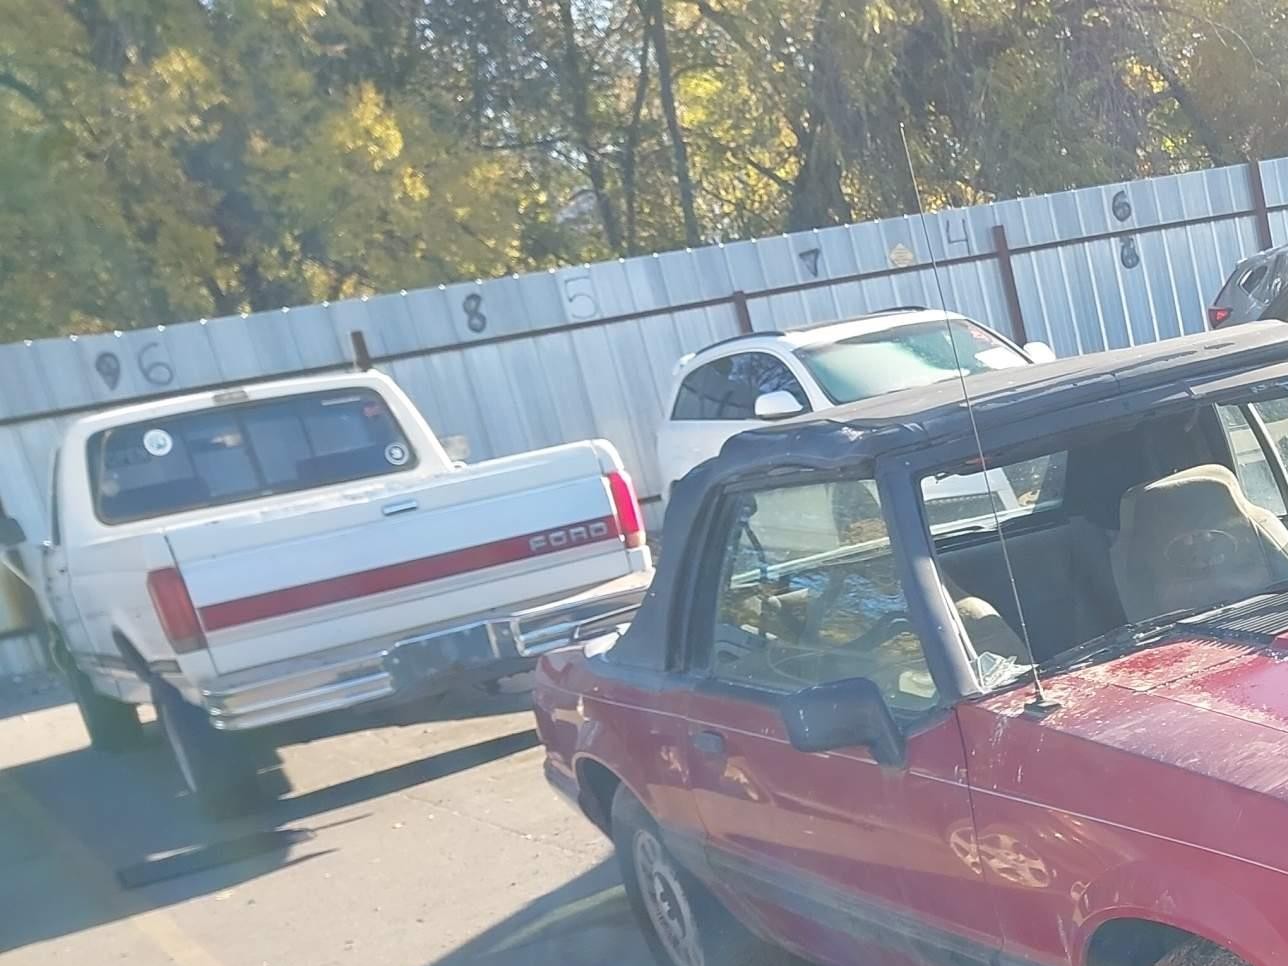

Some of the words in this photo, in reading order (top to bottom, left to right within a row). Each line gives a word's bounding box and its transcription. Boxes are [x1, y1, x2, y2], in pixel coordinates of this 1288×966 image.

[1111, 189, 1132, 222] 6
[946, 218, 971, 256] 4
[462, 292, 487, 333] 8
[564, 276, 599, 320] 5
[528, 521, 608, 552] FORD
